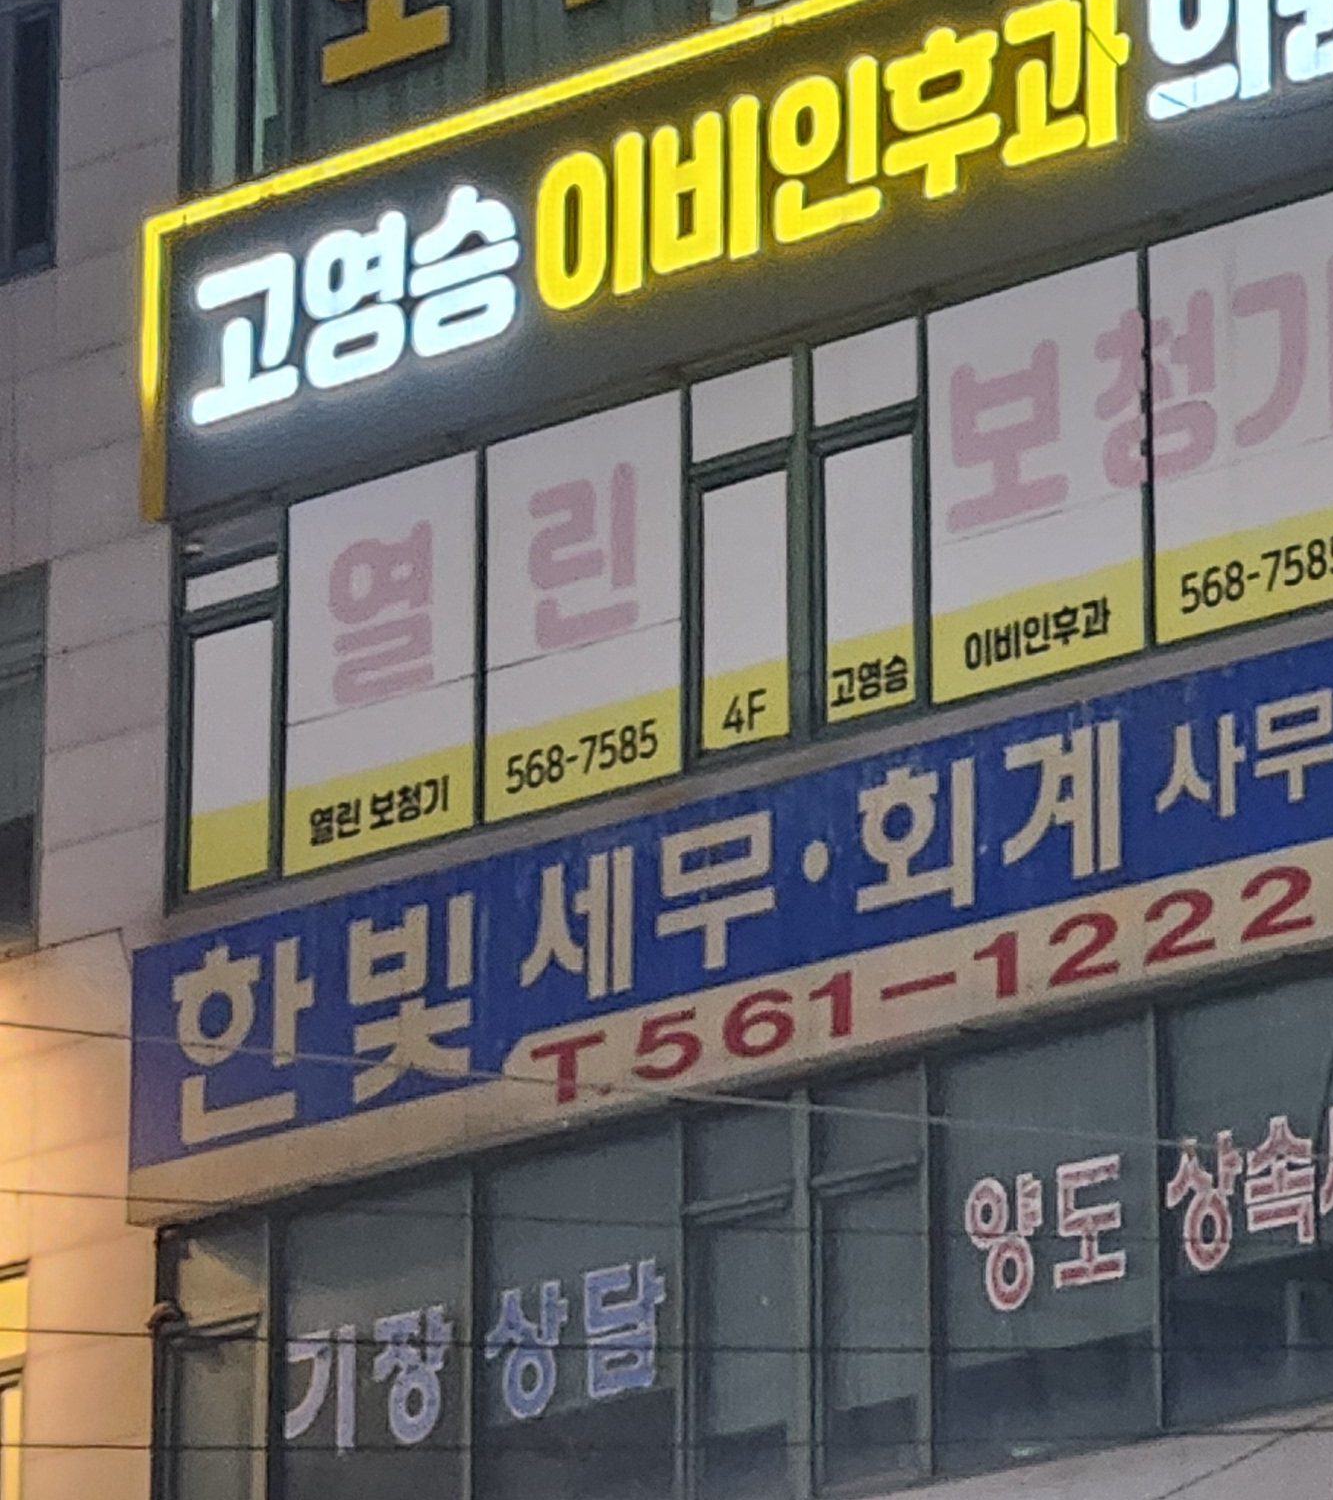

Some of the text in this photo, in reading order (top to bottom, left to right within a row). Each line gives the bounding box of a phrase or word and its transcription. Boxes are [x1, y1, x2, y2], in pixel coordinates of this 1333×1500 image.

[190, 183, 522, 428] 고영승
[829, 653, 909, 710] 고영승
[963, 596, 1112, 672] 이비인후과
[505, 718, 660, 796] 568-7585
[721, 688, 768, 738] 4F
[308, 774, 450, 846] 열린 보청기
[170, 894, 478, 1148] 한빛
[518, 720, 1126, 1002] 세무·회계
[530, 864, 1318, 1106] T.561-1222
[965, 1153, 1128, 1312] 양도
[284, 1258, 668, 1460] 기장 상담
